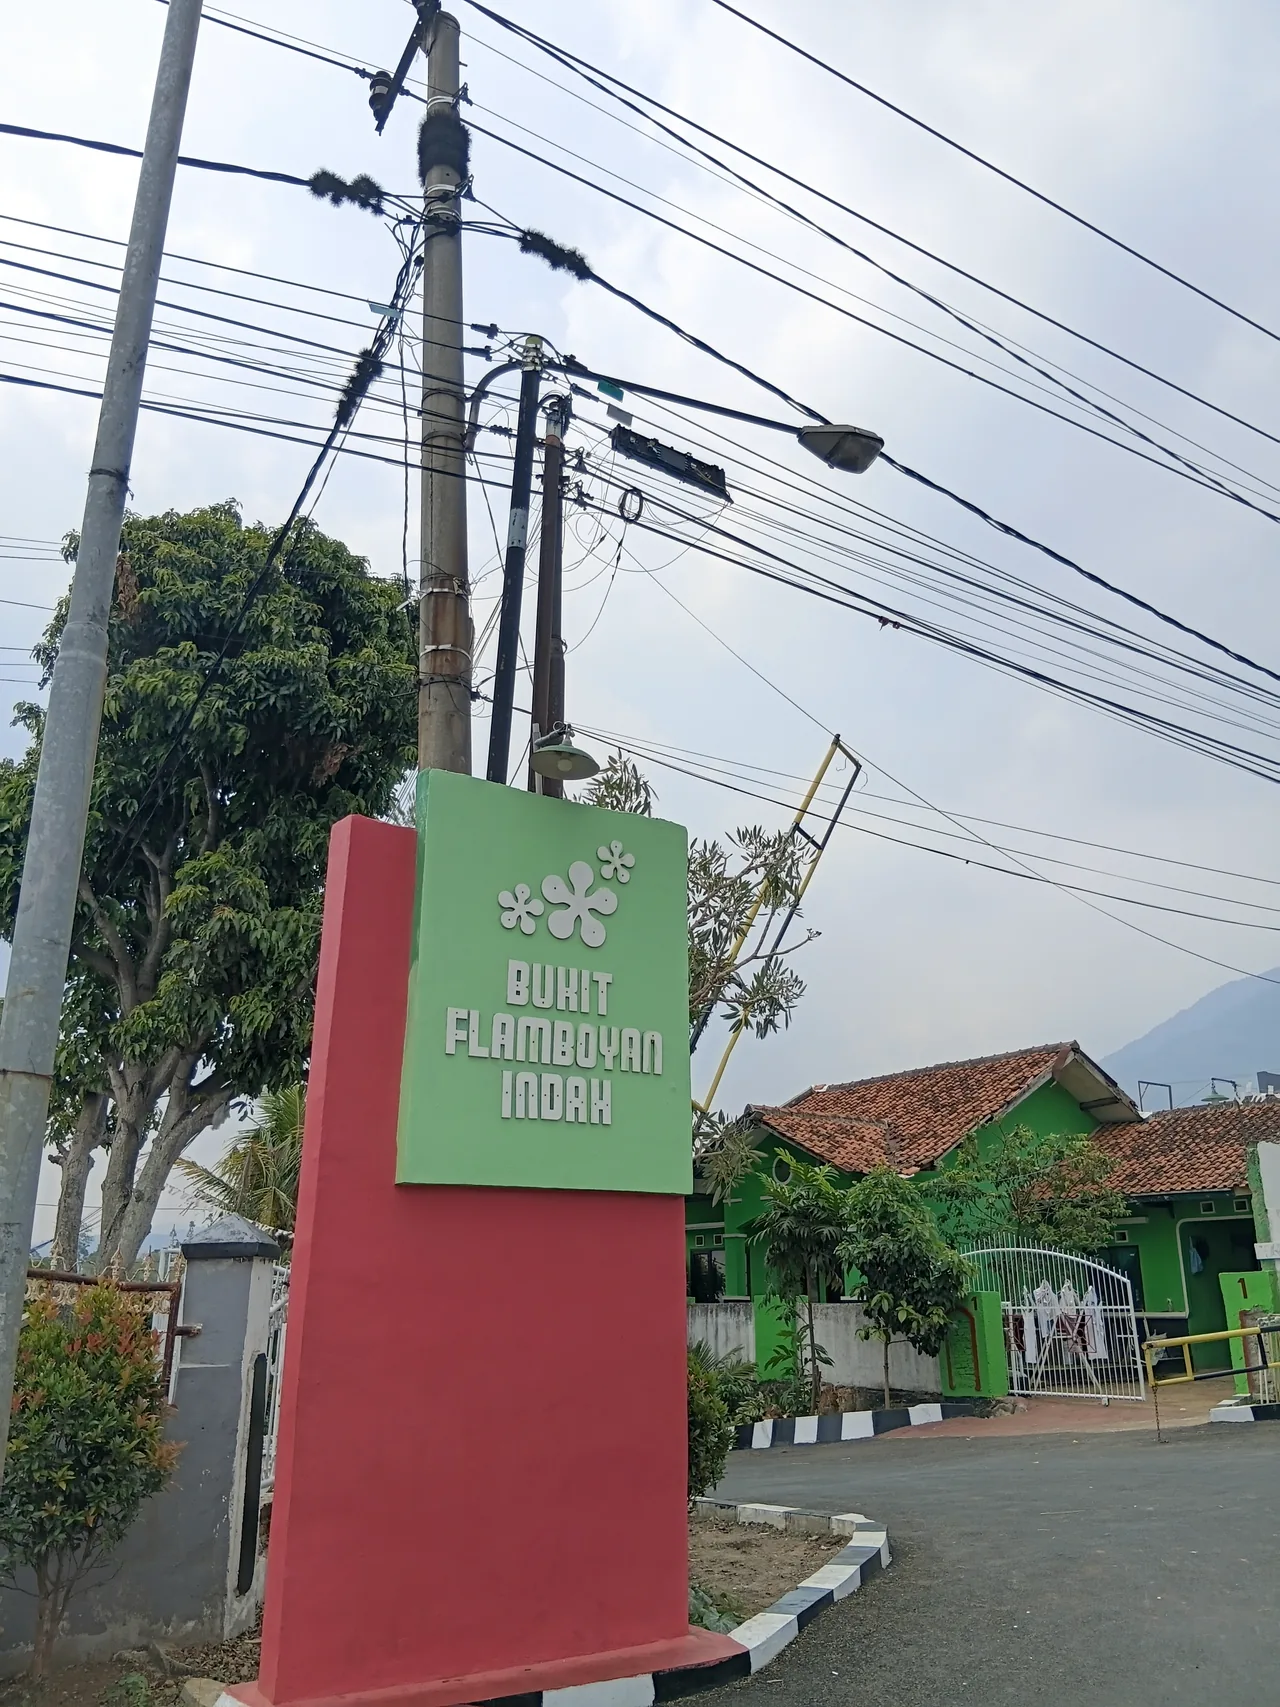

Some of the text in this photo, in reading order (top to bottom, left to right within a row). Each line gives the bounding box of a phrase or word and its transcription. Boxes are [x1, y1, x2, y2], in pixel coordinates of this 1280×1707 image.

[506, 959, 613, 1016] BUKIT
[445, 1006, 663, 1075] FLAMBOYAN
[501, 1070, 612, 1125] INDAH
[970, 1296, 978, 1311] 1
[1237, 1277, 1248, 1299] 1
